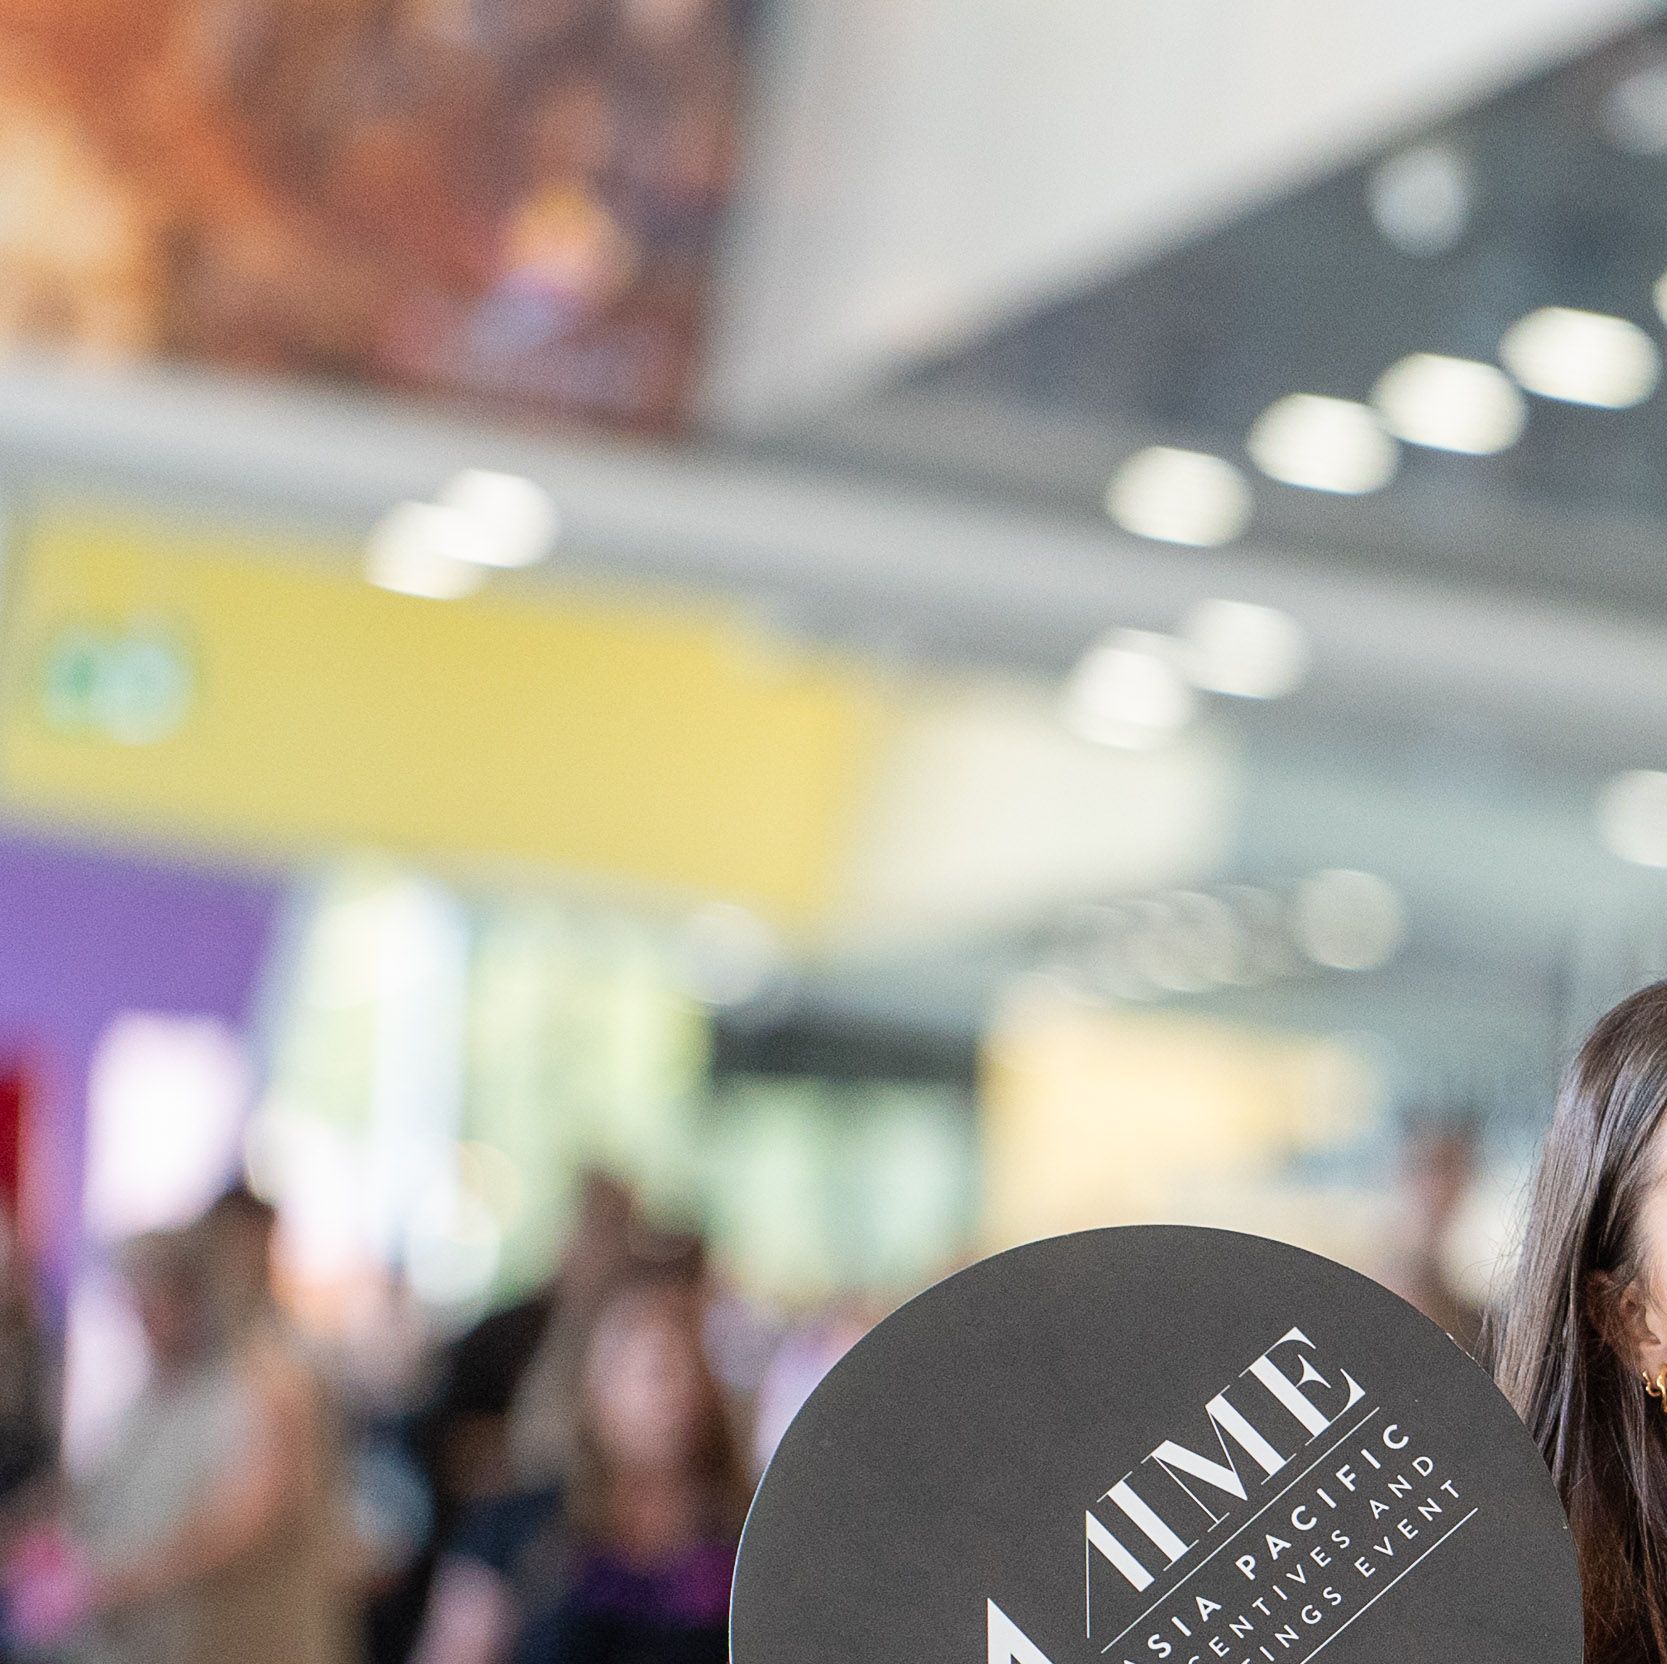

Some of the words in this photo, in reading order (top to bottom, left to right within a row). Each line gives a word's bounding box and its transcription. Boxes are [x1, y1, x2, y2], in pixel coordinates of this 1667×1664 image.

[1086, 1327, 1365, 1639] AIME
[1235, 1424, 1413, 1580] PACIFIC
[1355, 1480, 1463, 1577] EVENT
[1368, 1455, 1436, 1519] AND
